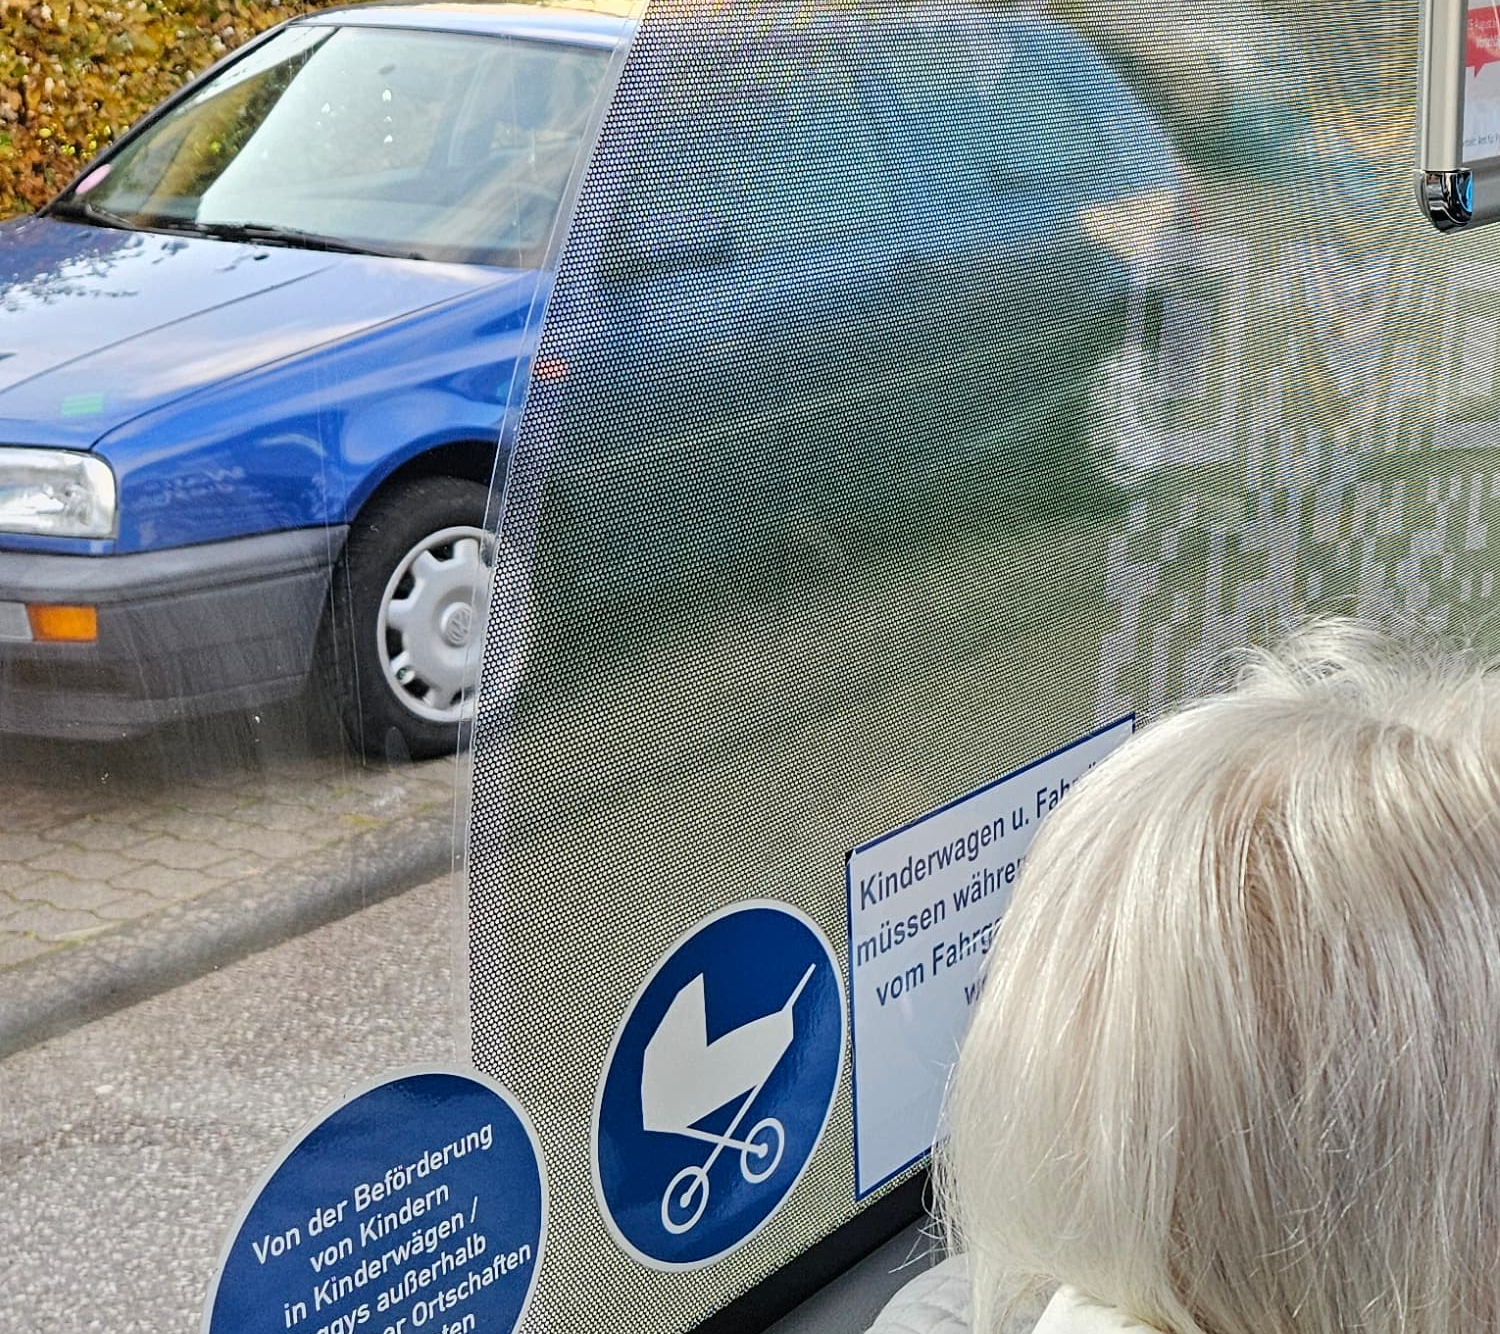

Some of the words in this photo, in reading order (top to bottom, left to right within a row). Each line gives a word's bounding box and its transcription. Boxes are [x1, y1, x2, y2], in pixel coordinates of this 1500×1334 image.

[860, 816, 1005, 910] Kinderwagen
[1012, 807, 1029, 831] u.
[857, 899, 946, 966] müssen
[876, 962, 925, 1007] vom
[252, 1227, 300, 1266] Von
[308, 1198, 347, 1237] der
[354, 1123, 493, 1213] Beförderung
[310, 1239, 352, 1273] von
[360, 1183, 449, 1247] Kindern
[284, 1302, 306, 1328] in
[314, 1211, 464, 1311] Kinderwägen
[471, 1196, 479, 1225] /
[377, 1232, 487, 1313] außerhalb
[412, 1242, 532, 1328] Ortschaften
